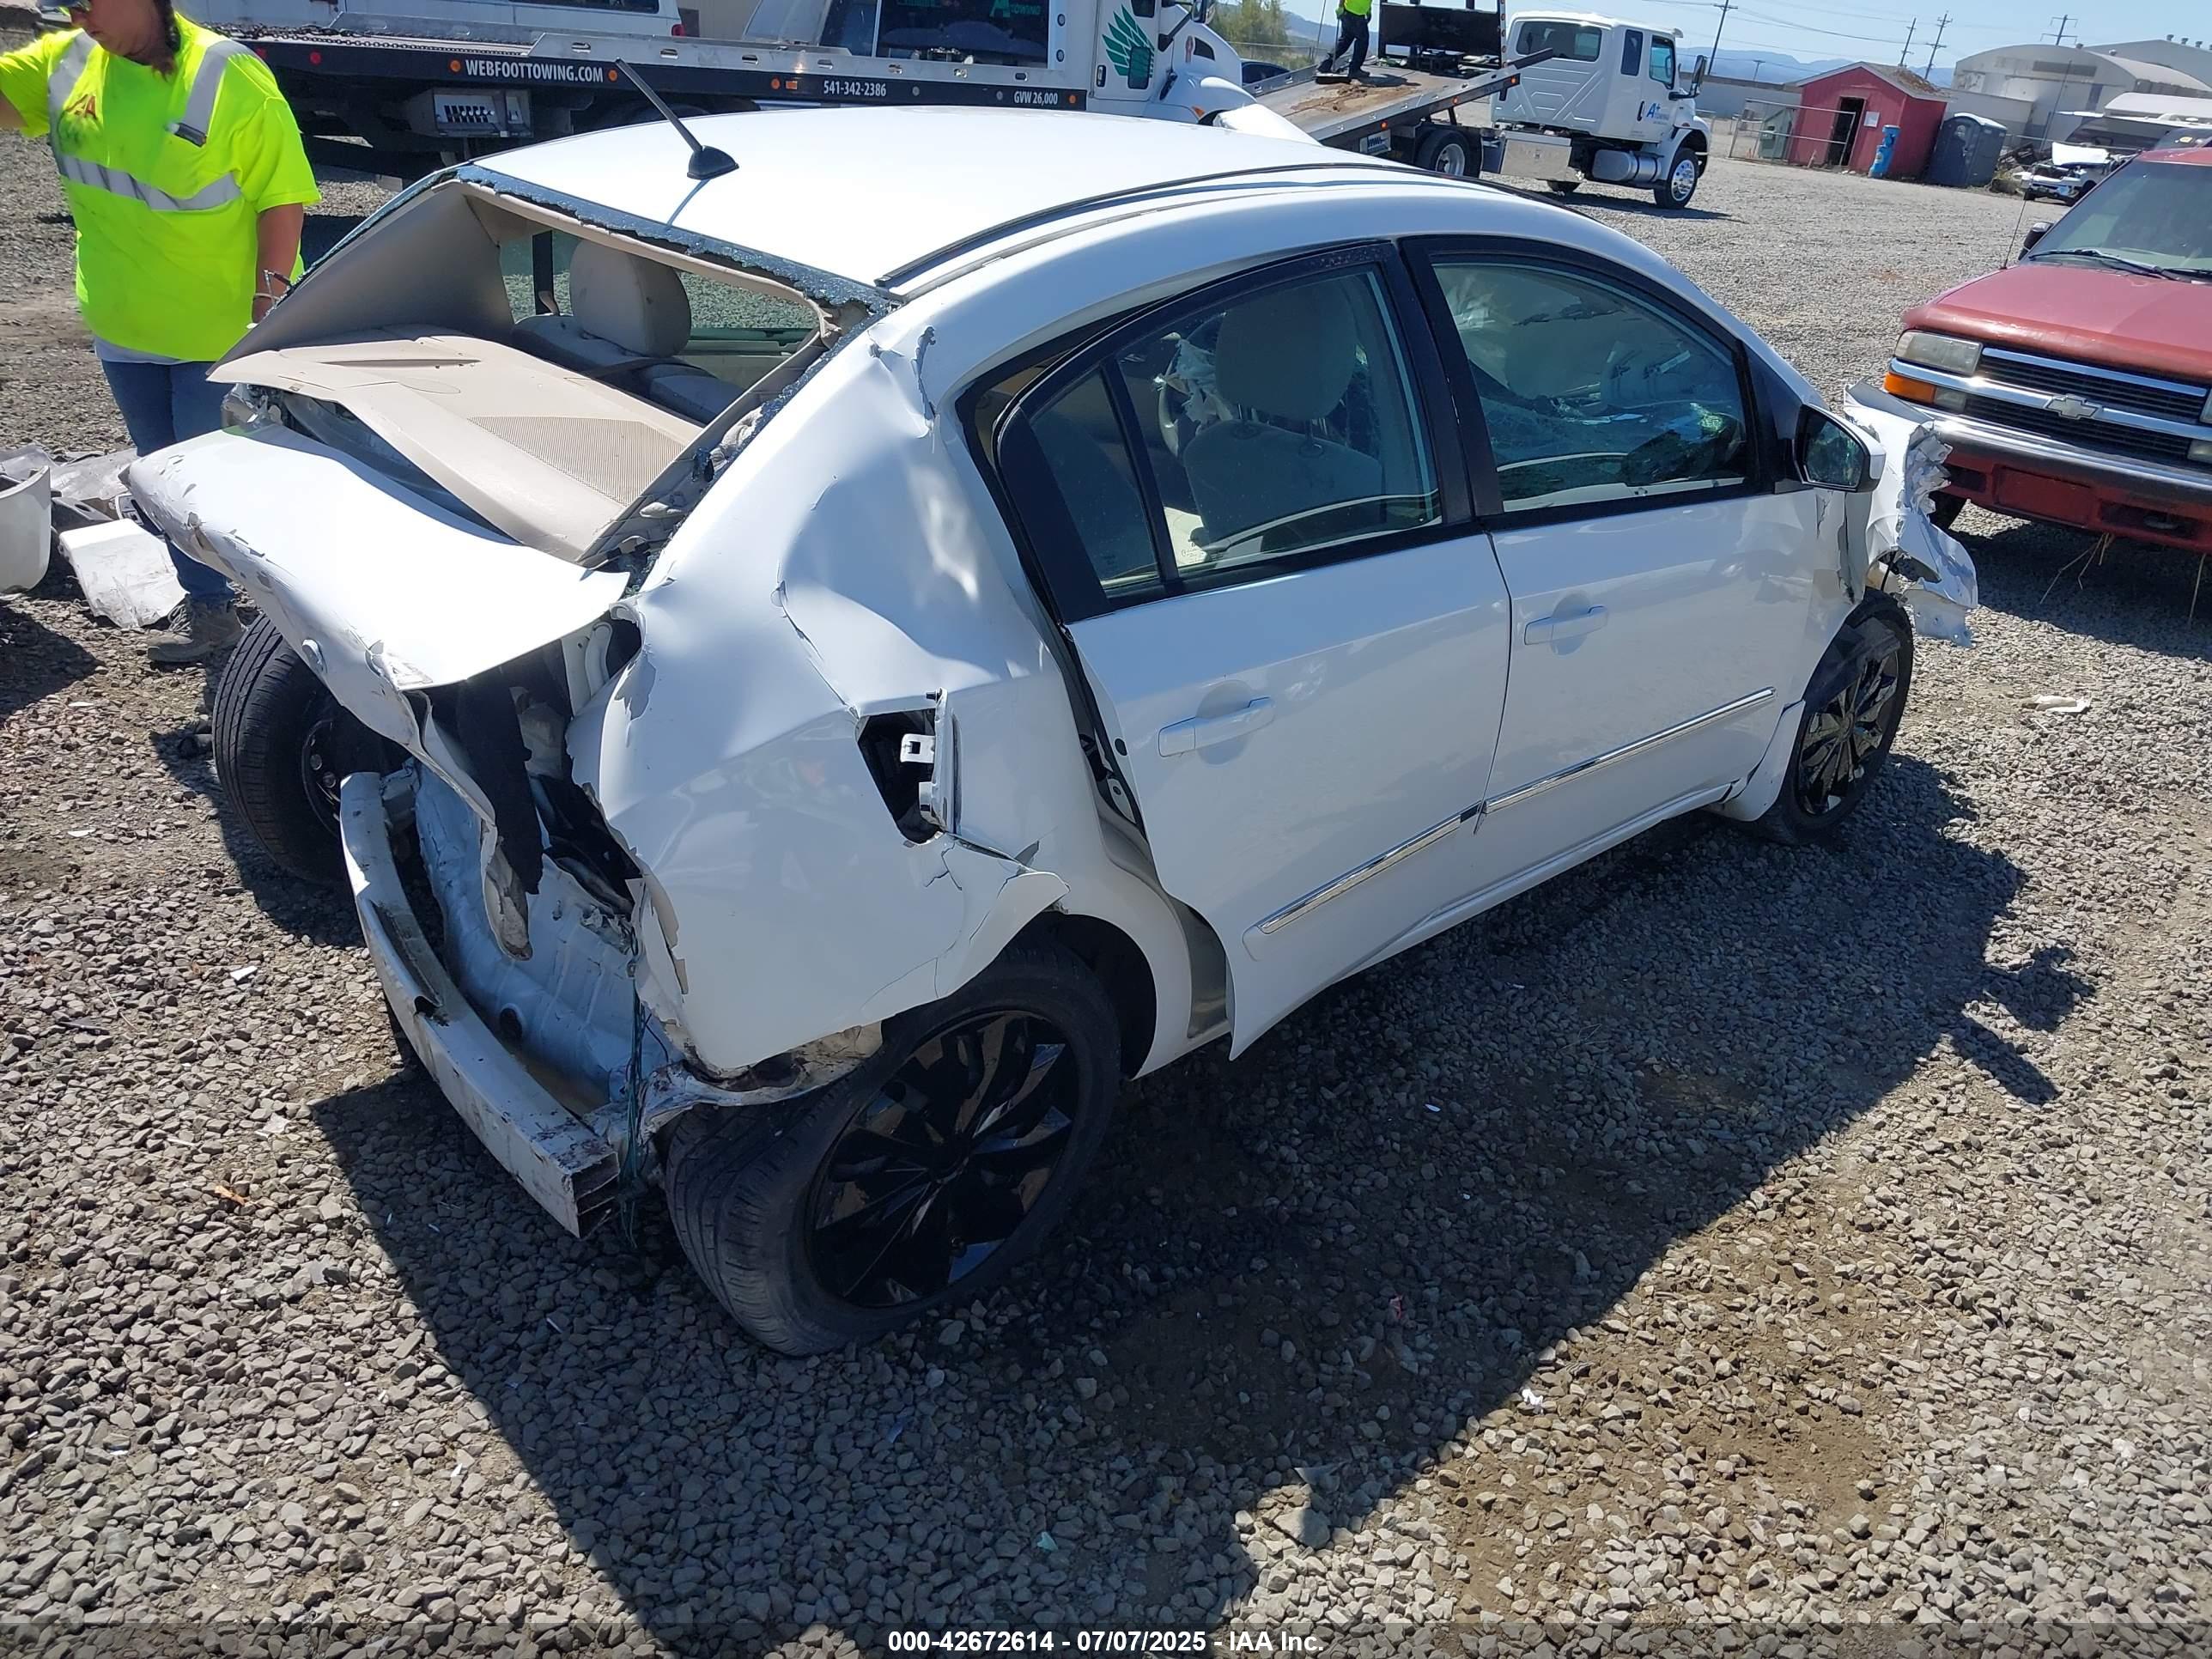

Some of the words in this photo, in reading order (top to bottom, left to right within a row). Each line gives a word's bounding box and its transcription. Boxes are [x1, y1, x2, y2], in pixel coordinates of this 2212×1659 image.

[465, 59, 604, 82] WEBFOOTTOWING.COM
[823, 81, 886, 97] 541-342-2386
[1013, 91, 1033, 104] GVW
[1032, 93, 1058, 105] 26,000
